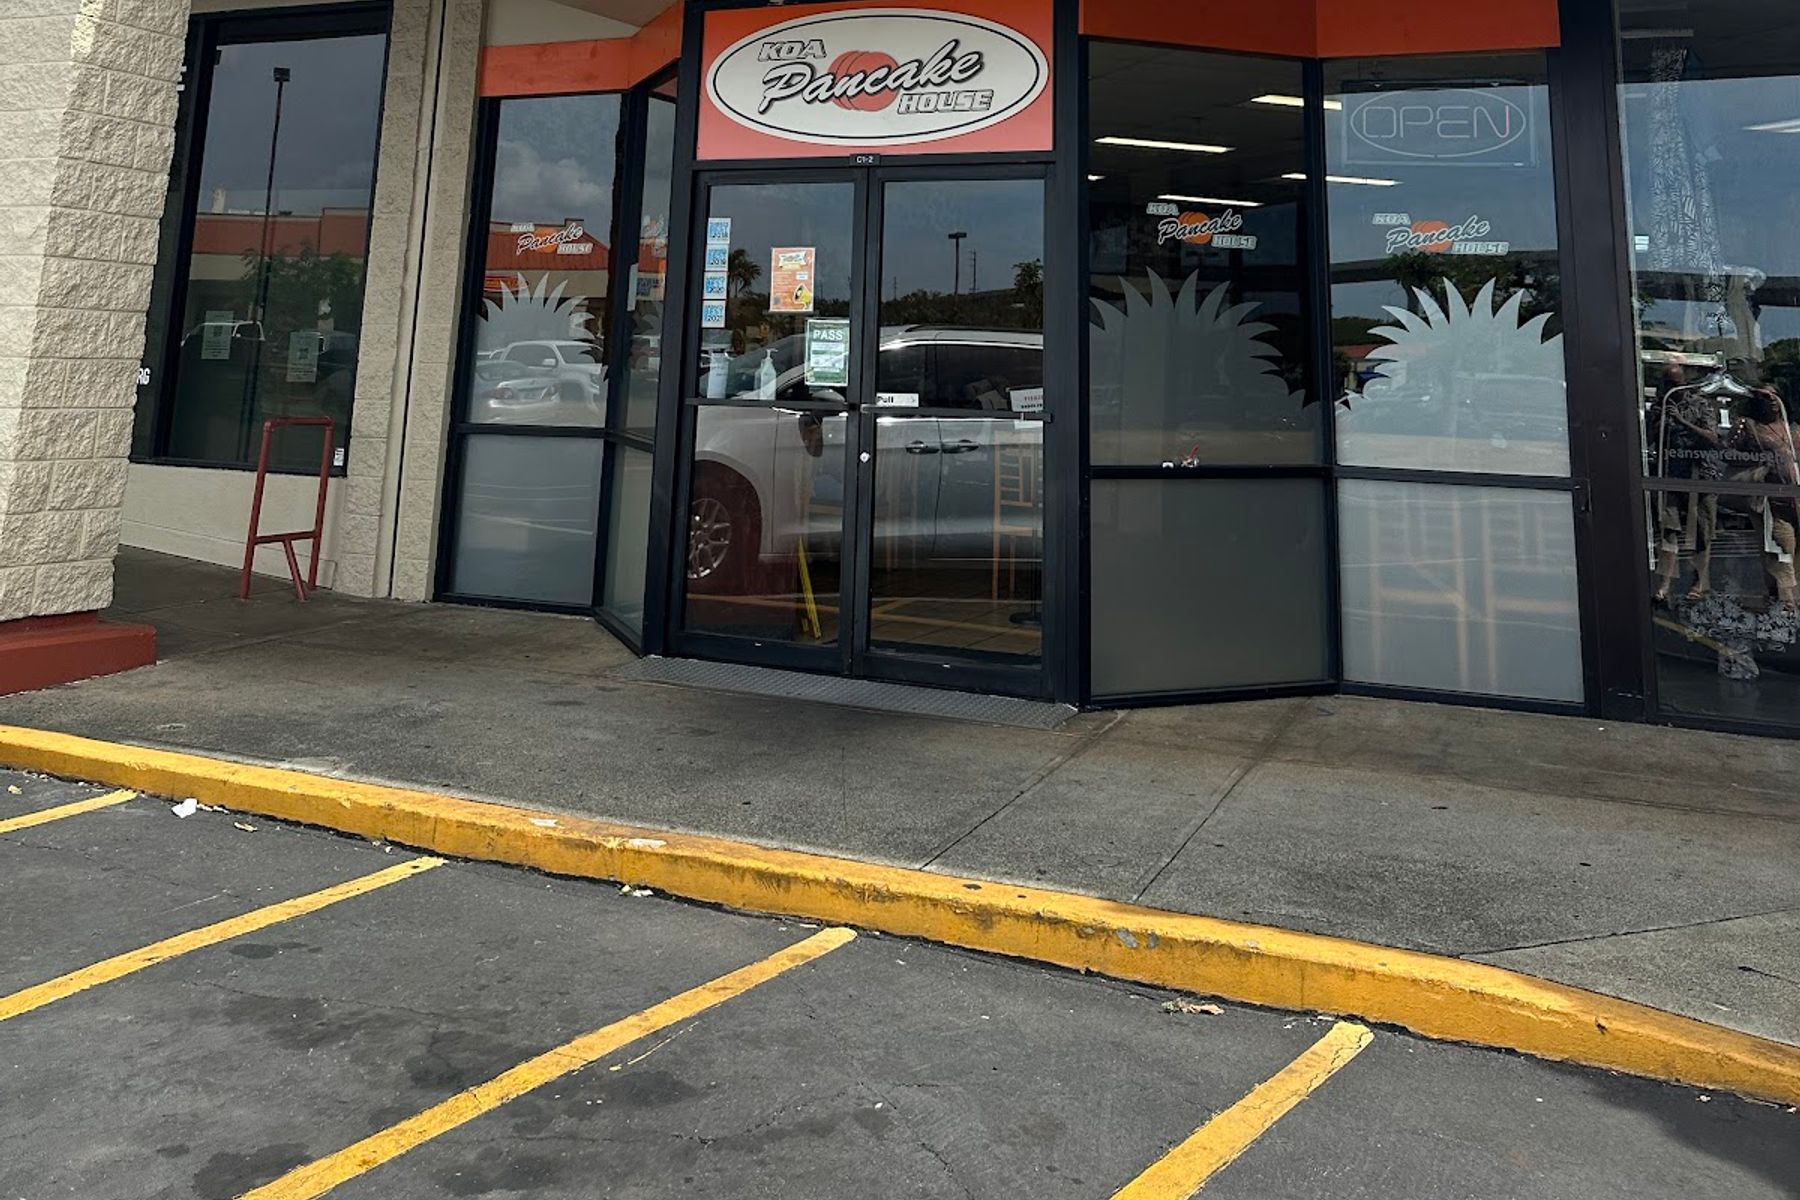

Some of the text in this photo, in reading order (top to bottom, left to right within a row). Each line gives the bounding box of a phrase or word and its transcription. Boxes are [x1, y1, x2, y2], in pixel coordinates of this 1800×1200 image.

[757, 39, 828, 62] KOA
[757, 38, 985, 115] Pancake
[896, 89, 994, 115] HOUSE
[1361, 104, 1512, 140] OPEN
[515, 222, 584, 257] Pancake
[1157, 208, 1243, 245] Pancake
[1211, 234, 1257, 249] HOUSE
[1385, 214, 1491, 254] Pancake
[1452, 241, 1510, 256] HOUSE
[813, 329, 844, 341] PASS
